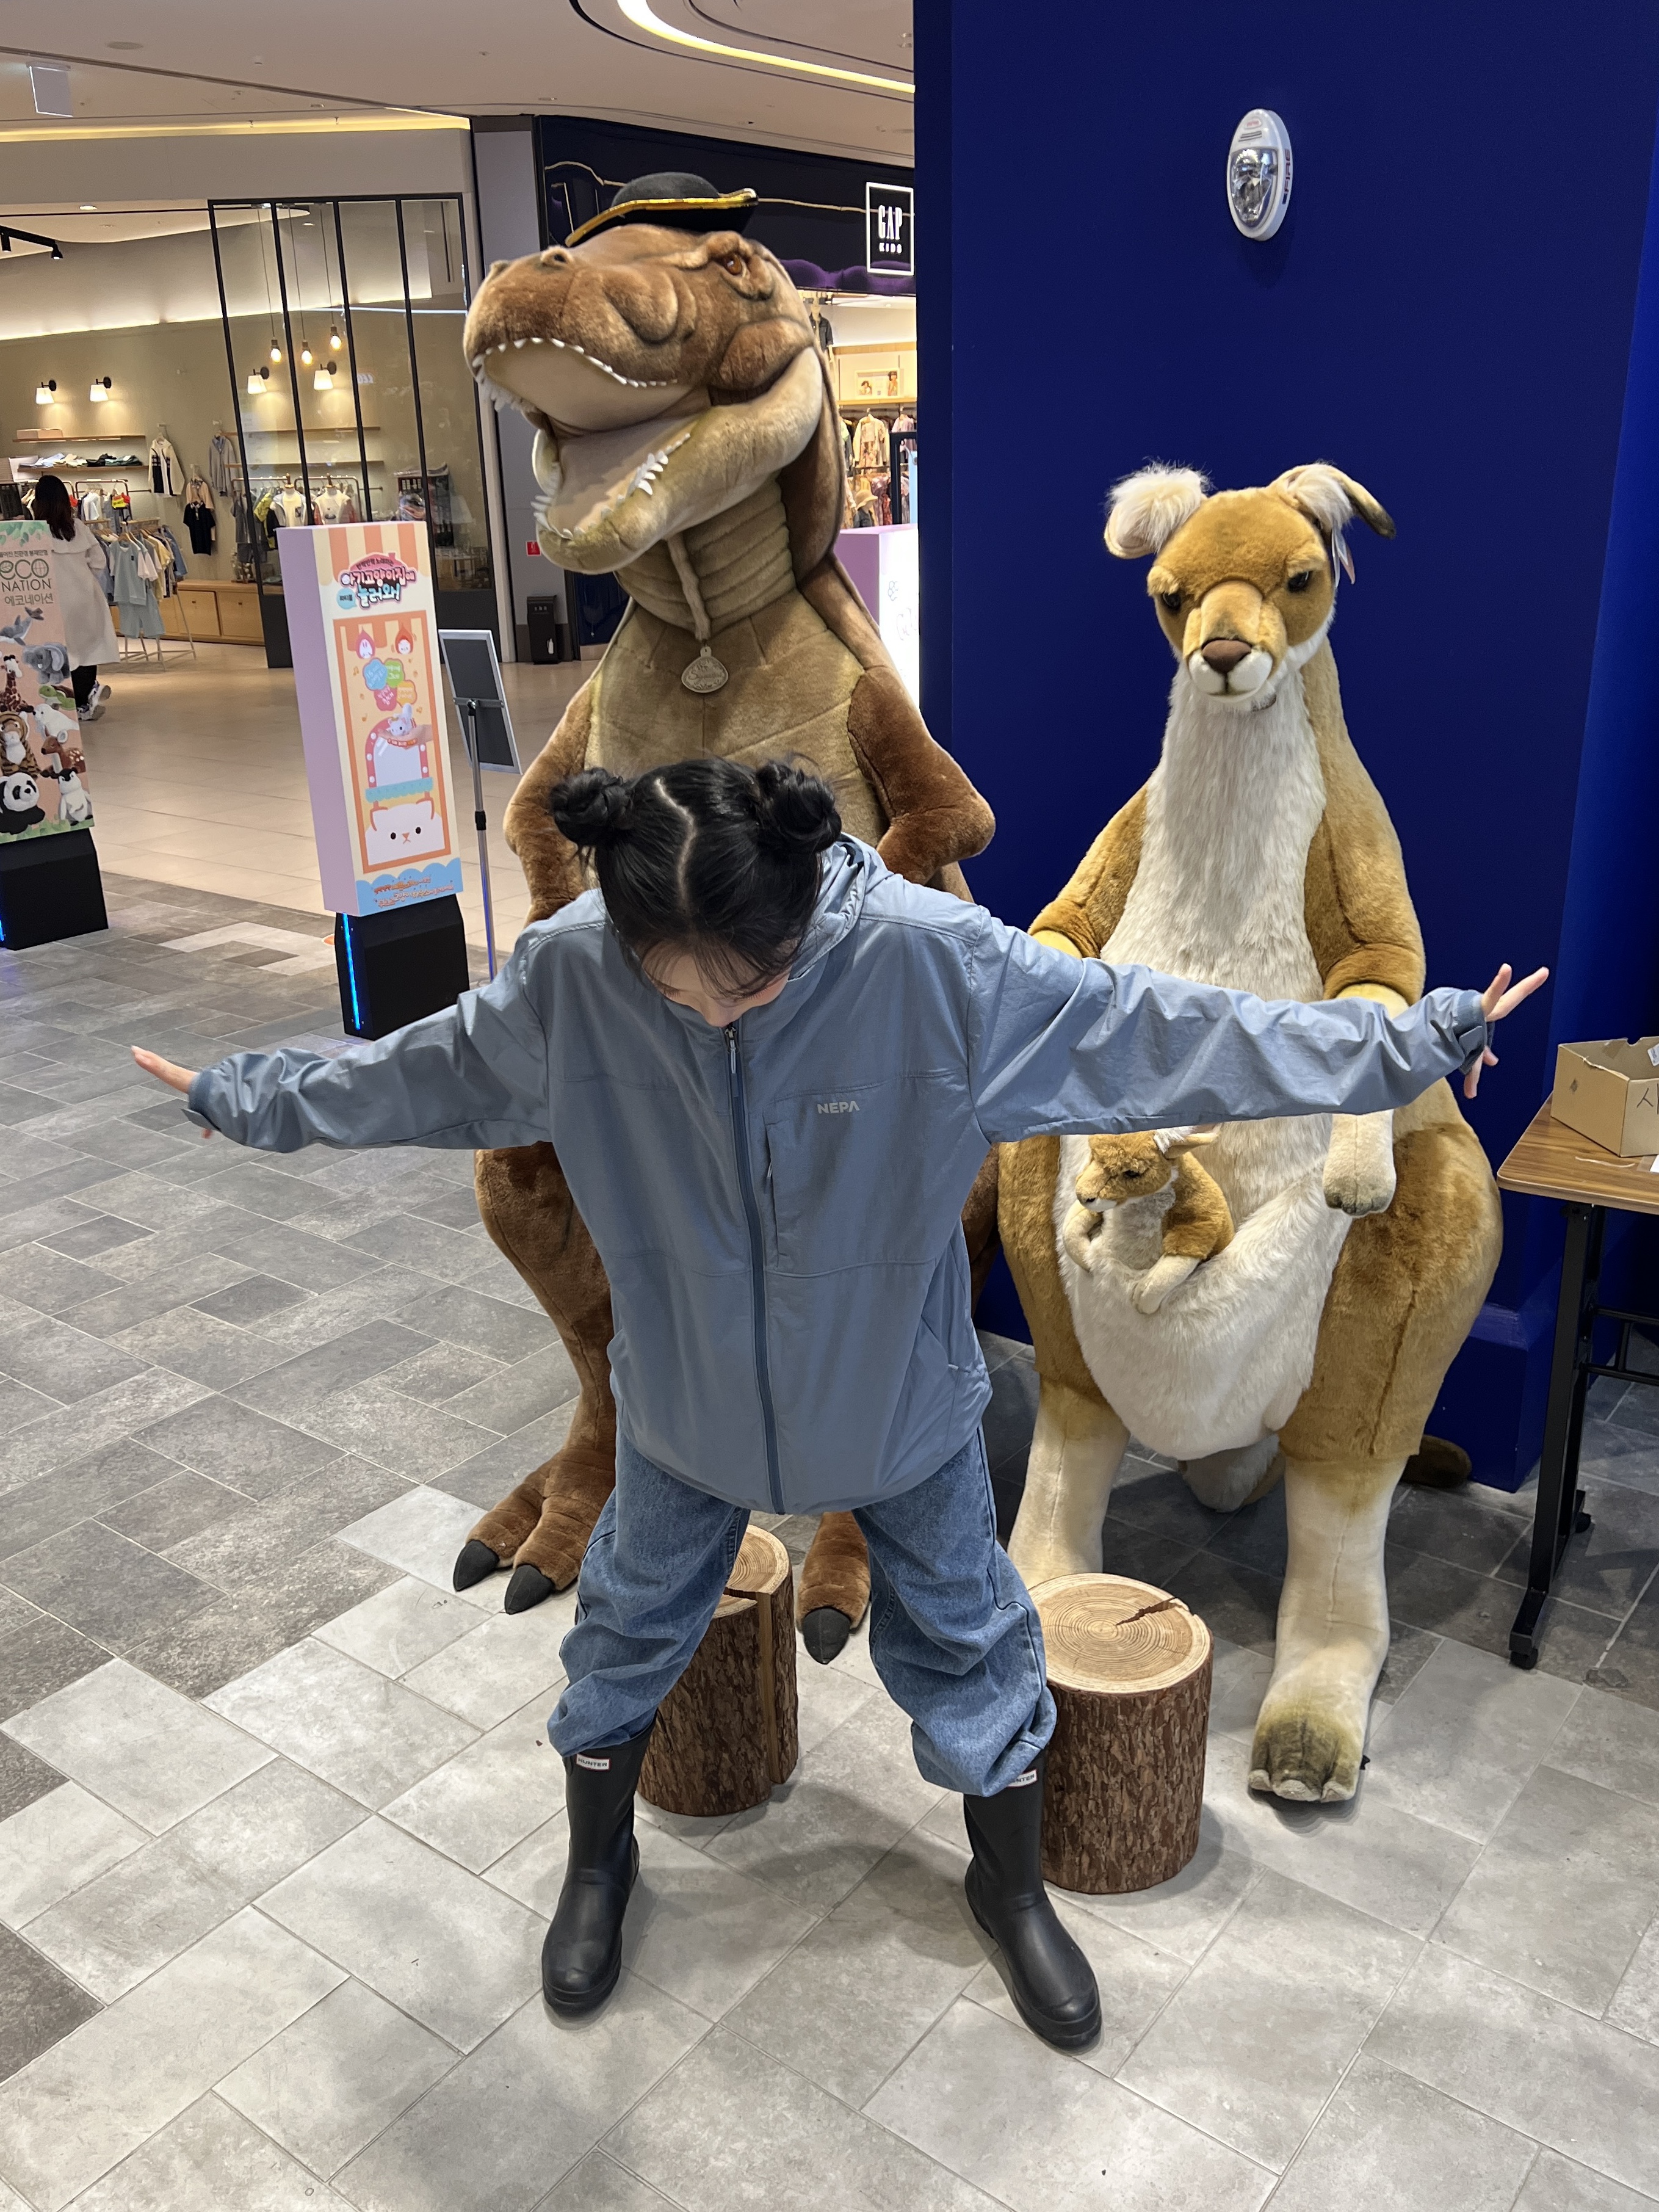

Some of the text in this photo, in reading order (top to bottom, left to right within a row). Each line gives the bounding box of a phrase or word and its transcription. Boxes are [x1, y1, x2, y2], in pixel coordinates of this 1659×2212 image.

[878, 205, 903, 241] GAP
[879, 242, 902, 254] KIDS
[1, 579, 51, 593] NATION
[4, 593, 54, 606] 에코네이션
[817, 1101, 860, 1114] NEPA
[578, 1758, 607, 1766] HUNTER
